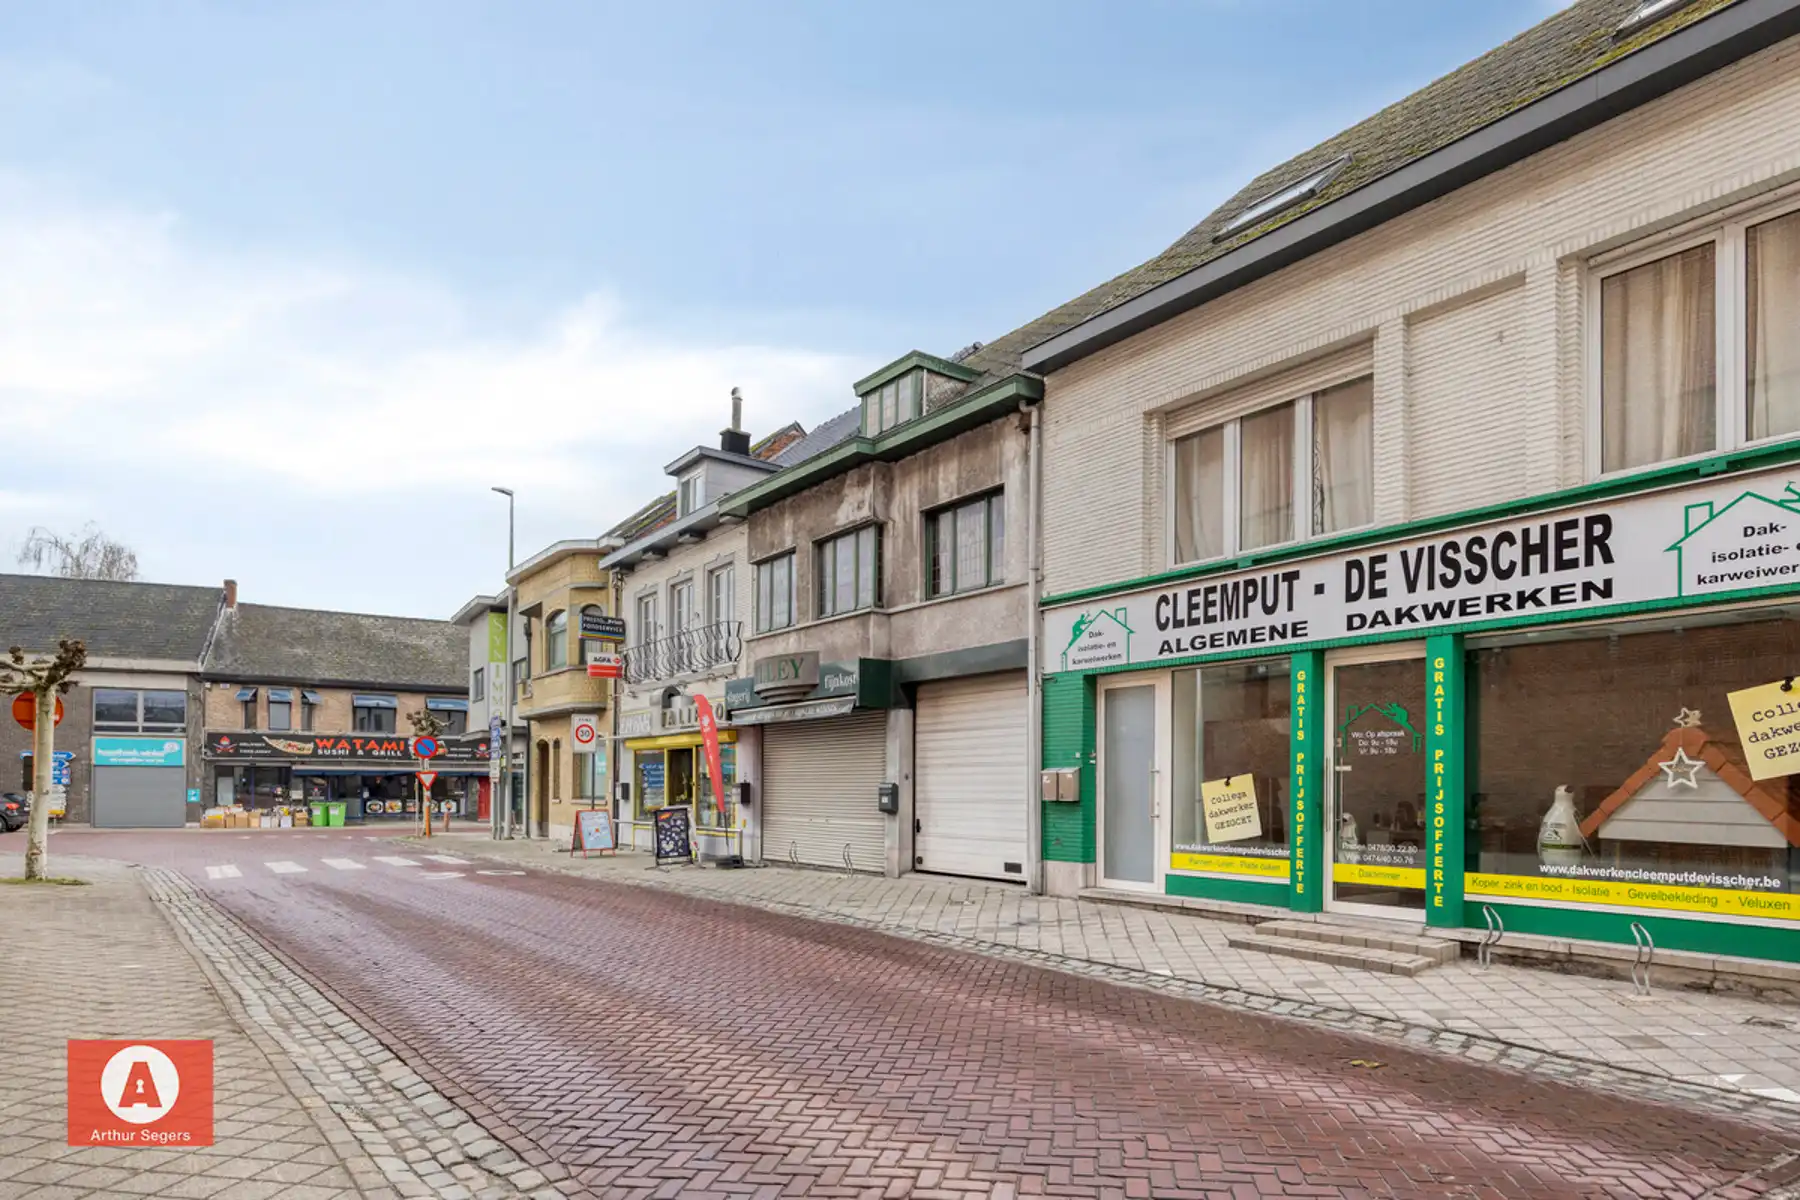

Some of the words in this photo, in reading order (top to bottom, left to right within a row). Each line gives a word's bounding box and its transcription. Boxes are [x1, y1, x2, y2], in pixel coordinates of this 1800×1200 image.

[1743, 522, 1787, 538] Dak-
[1712, 543, 1789, 563] isolatie-
[1155, 570, 1300, 632] CLEEMPUT
[1345, 554, 1388, 604] DE
[1400, 513, 1615, 594] VISSCHER
[1346, 578, 1613, 632] DAKWERKEN
[1088, 630, 1105, 639] Dak-
[1106, 641, 1117, 649] en
[1158, 620, 1308, 656] ALGEMENE
[1296, 670, 1306, 741] GRATIS
[1433, 657, 1445, 736] GRATIS
[315, 738, 405, 751] WATAMI
[579, 730, 590, 738] 30
[317, 748, 349, 756] SUSHI
[1763, 742, 1800, 760] GEZ
[1296, 753, 1304, 894] PRIJSOFFERTE
[1433, 750, 1444, 907] PRIJSOFFERTE
[1539, 862, 1782, 890] www.dakwerkencleemputdevisscher.be
[1503, 879, 1524, 891] zink
[1525, 882, 1538, 892] en
[1541, 882, 1563, 894] lood
[1572, 885, 1609, 898] Isolatie
[1627, 887, 1718, 907] Gevelbekleding
[1738, 895, 1791, 911] Veluxen
